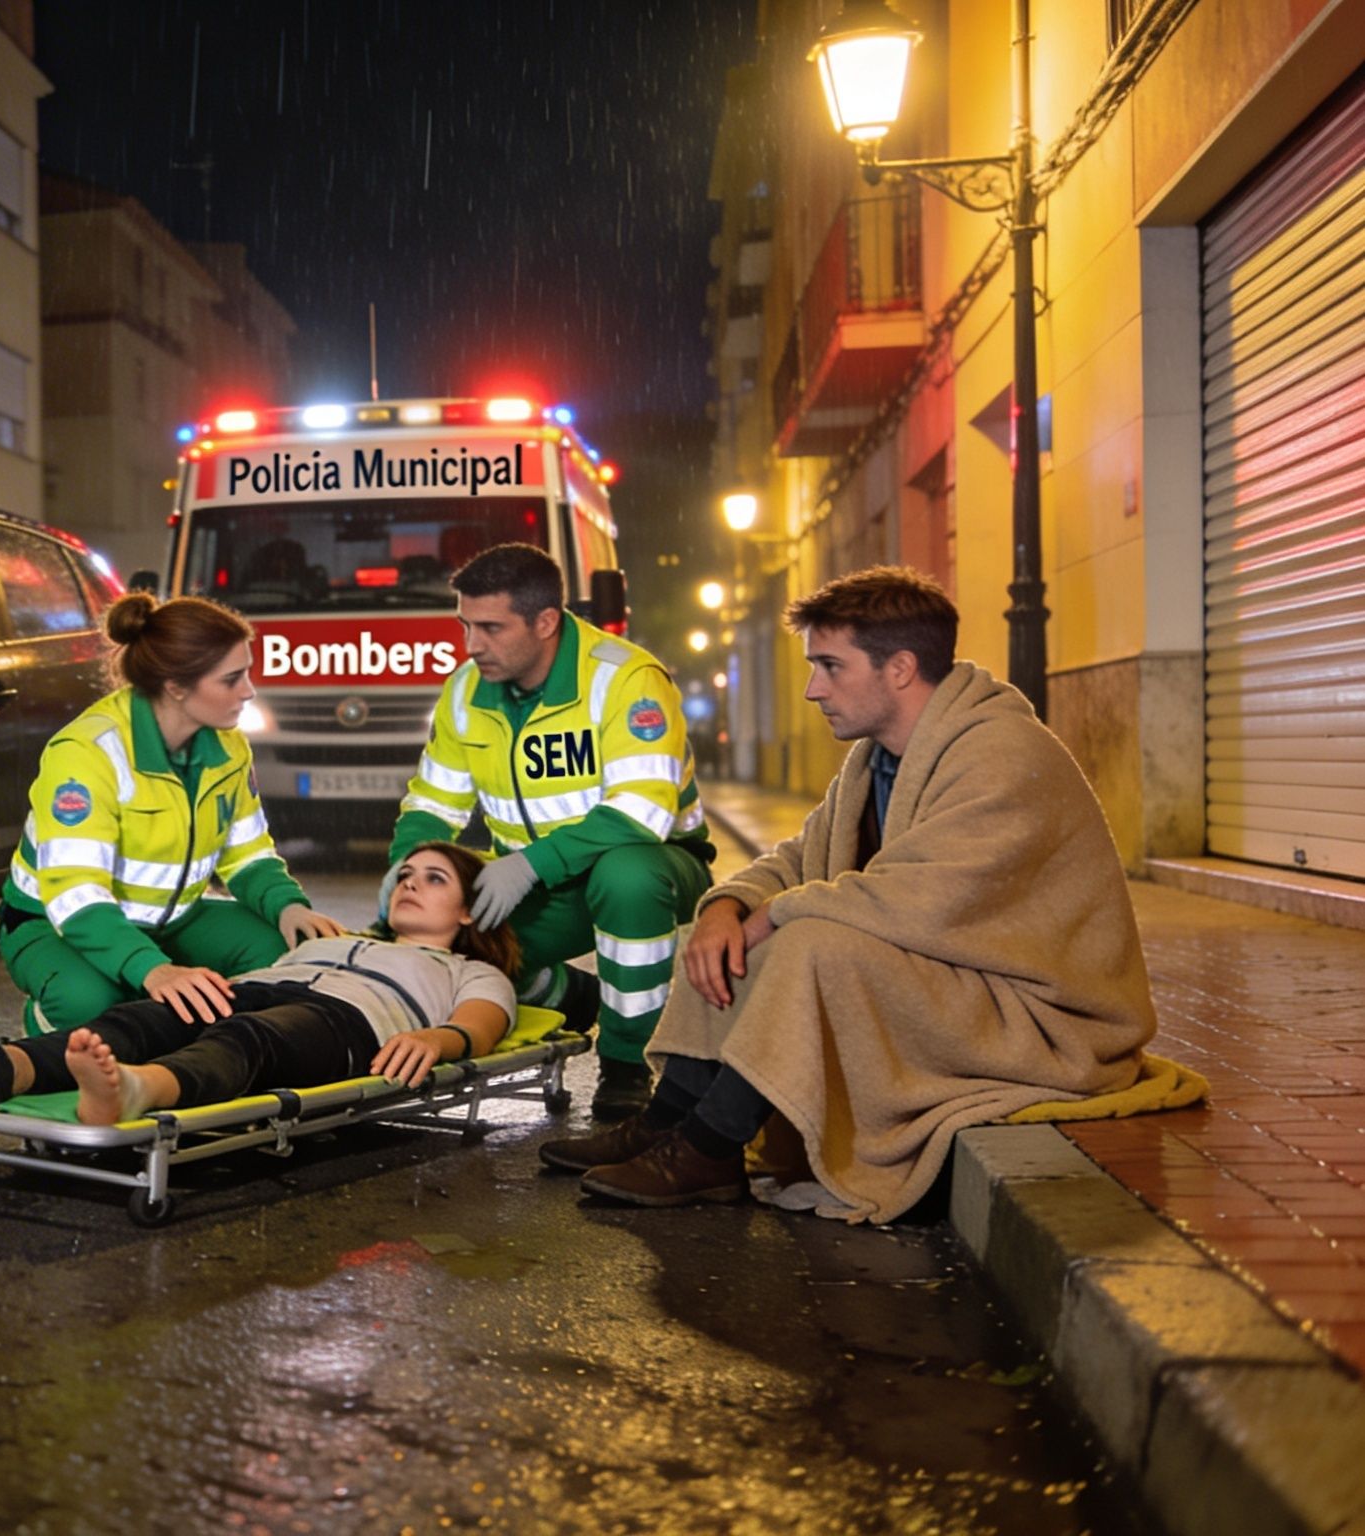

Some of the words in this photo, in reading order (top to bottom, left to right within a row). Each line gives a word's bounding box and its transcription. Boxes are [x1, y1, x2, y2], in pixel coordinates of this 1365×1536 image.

[353, 443, 523, 496] Municipal
[262, 631, 457, 677] Bombers
[523, 728, 597, 780] SEM
